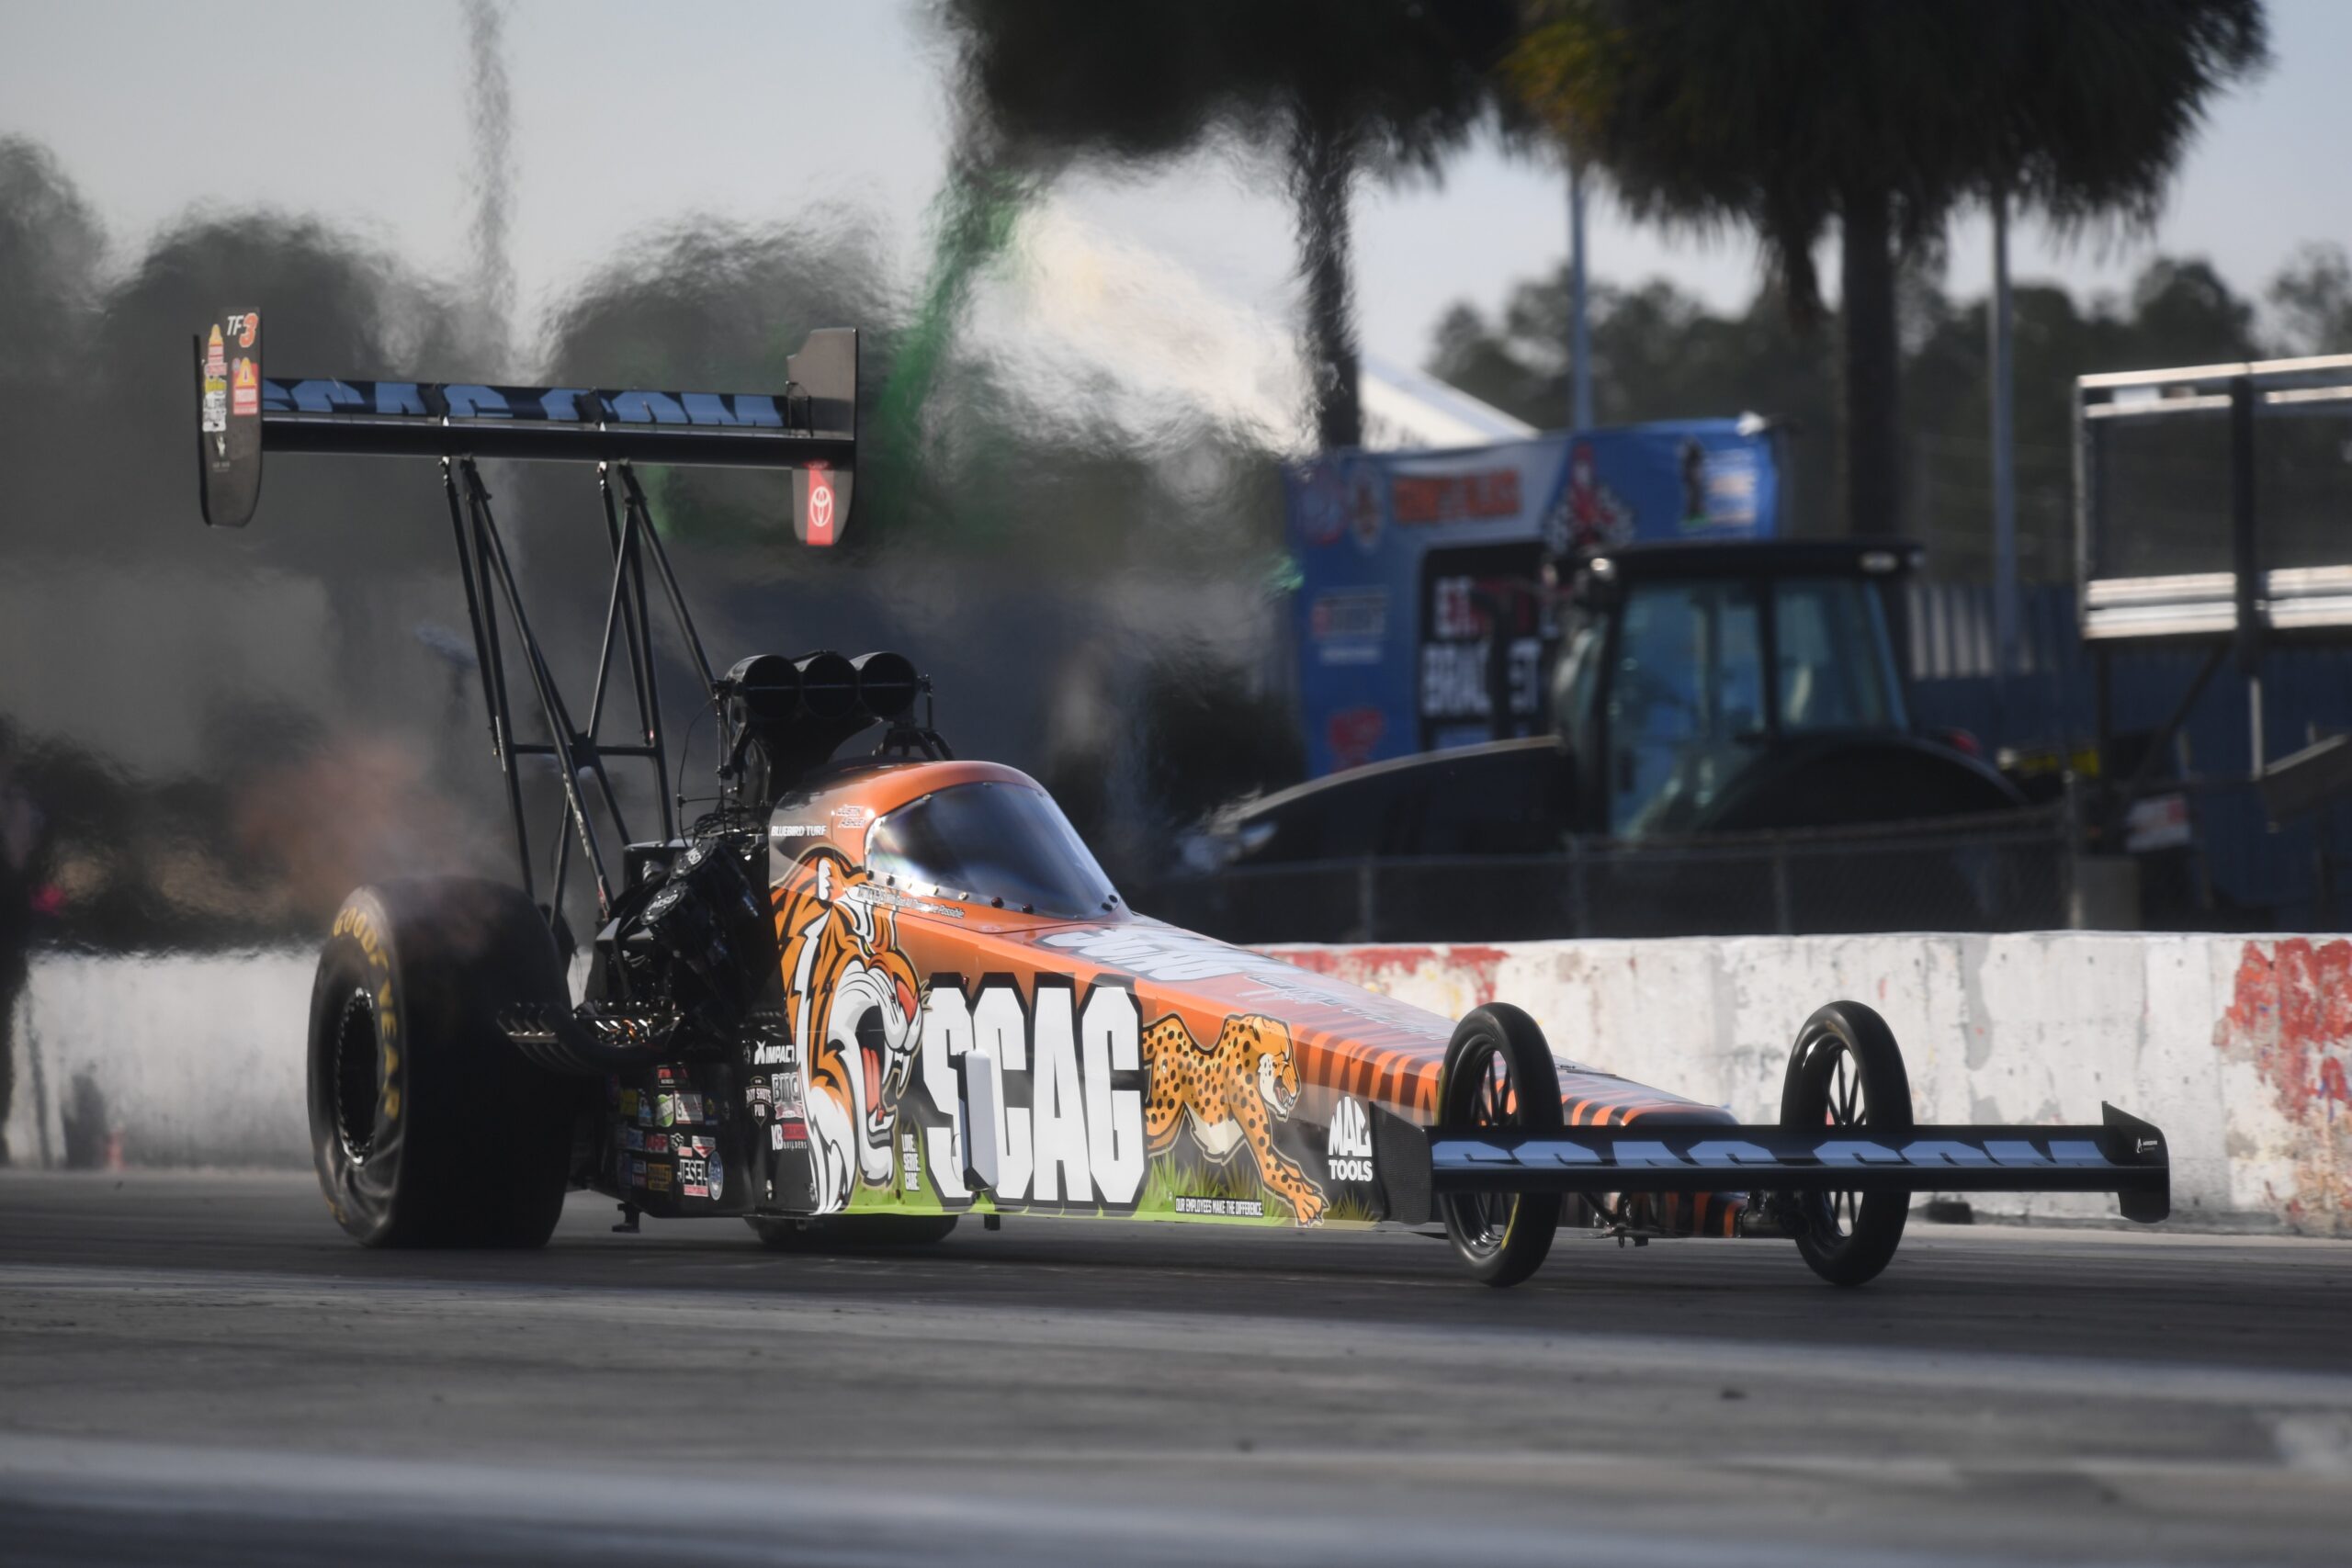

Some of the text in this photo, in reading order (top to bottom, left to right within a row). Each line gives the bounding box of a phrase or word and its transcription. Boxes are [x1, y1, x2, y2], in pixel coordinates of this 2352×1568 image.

[771, 825, 827, 837] BLUEBIRD TURF
[765, 1044, 795, 1065] IMPACT
[922, 987, 1146, 1203] SCAG
[754, 1103, 765, 1117] PUB
[1328, 1096, 1373, 1157] MAC
[676, 1158, 708, 1186] JESEL
[1328, 1159, 1374, 1182] TOOLS
[1175, 1198, 1185, 1213] OUR
[1185, 1198, 1213, 1213] EMPLOYEES
[1212, 1200, 1227, 1214] MAKE
[1226, 1201, 1236, 1215] THE
